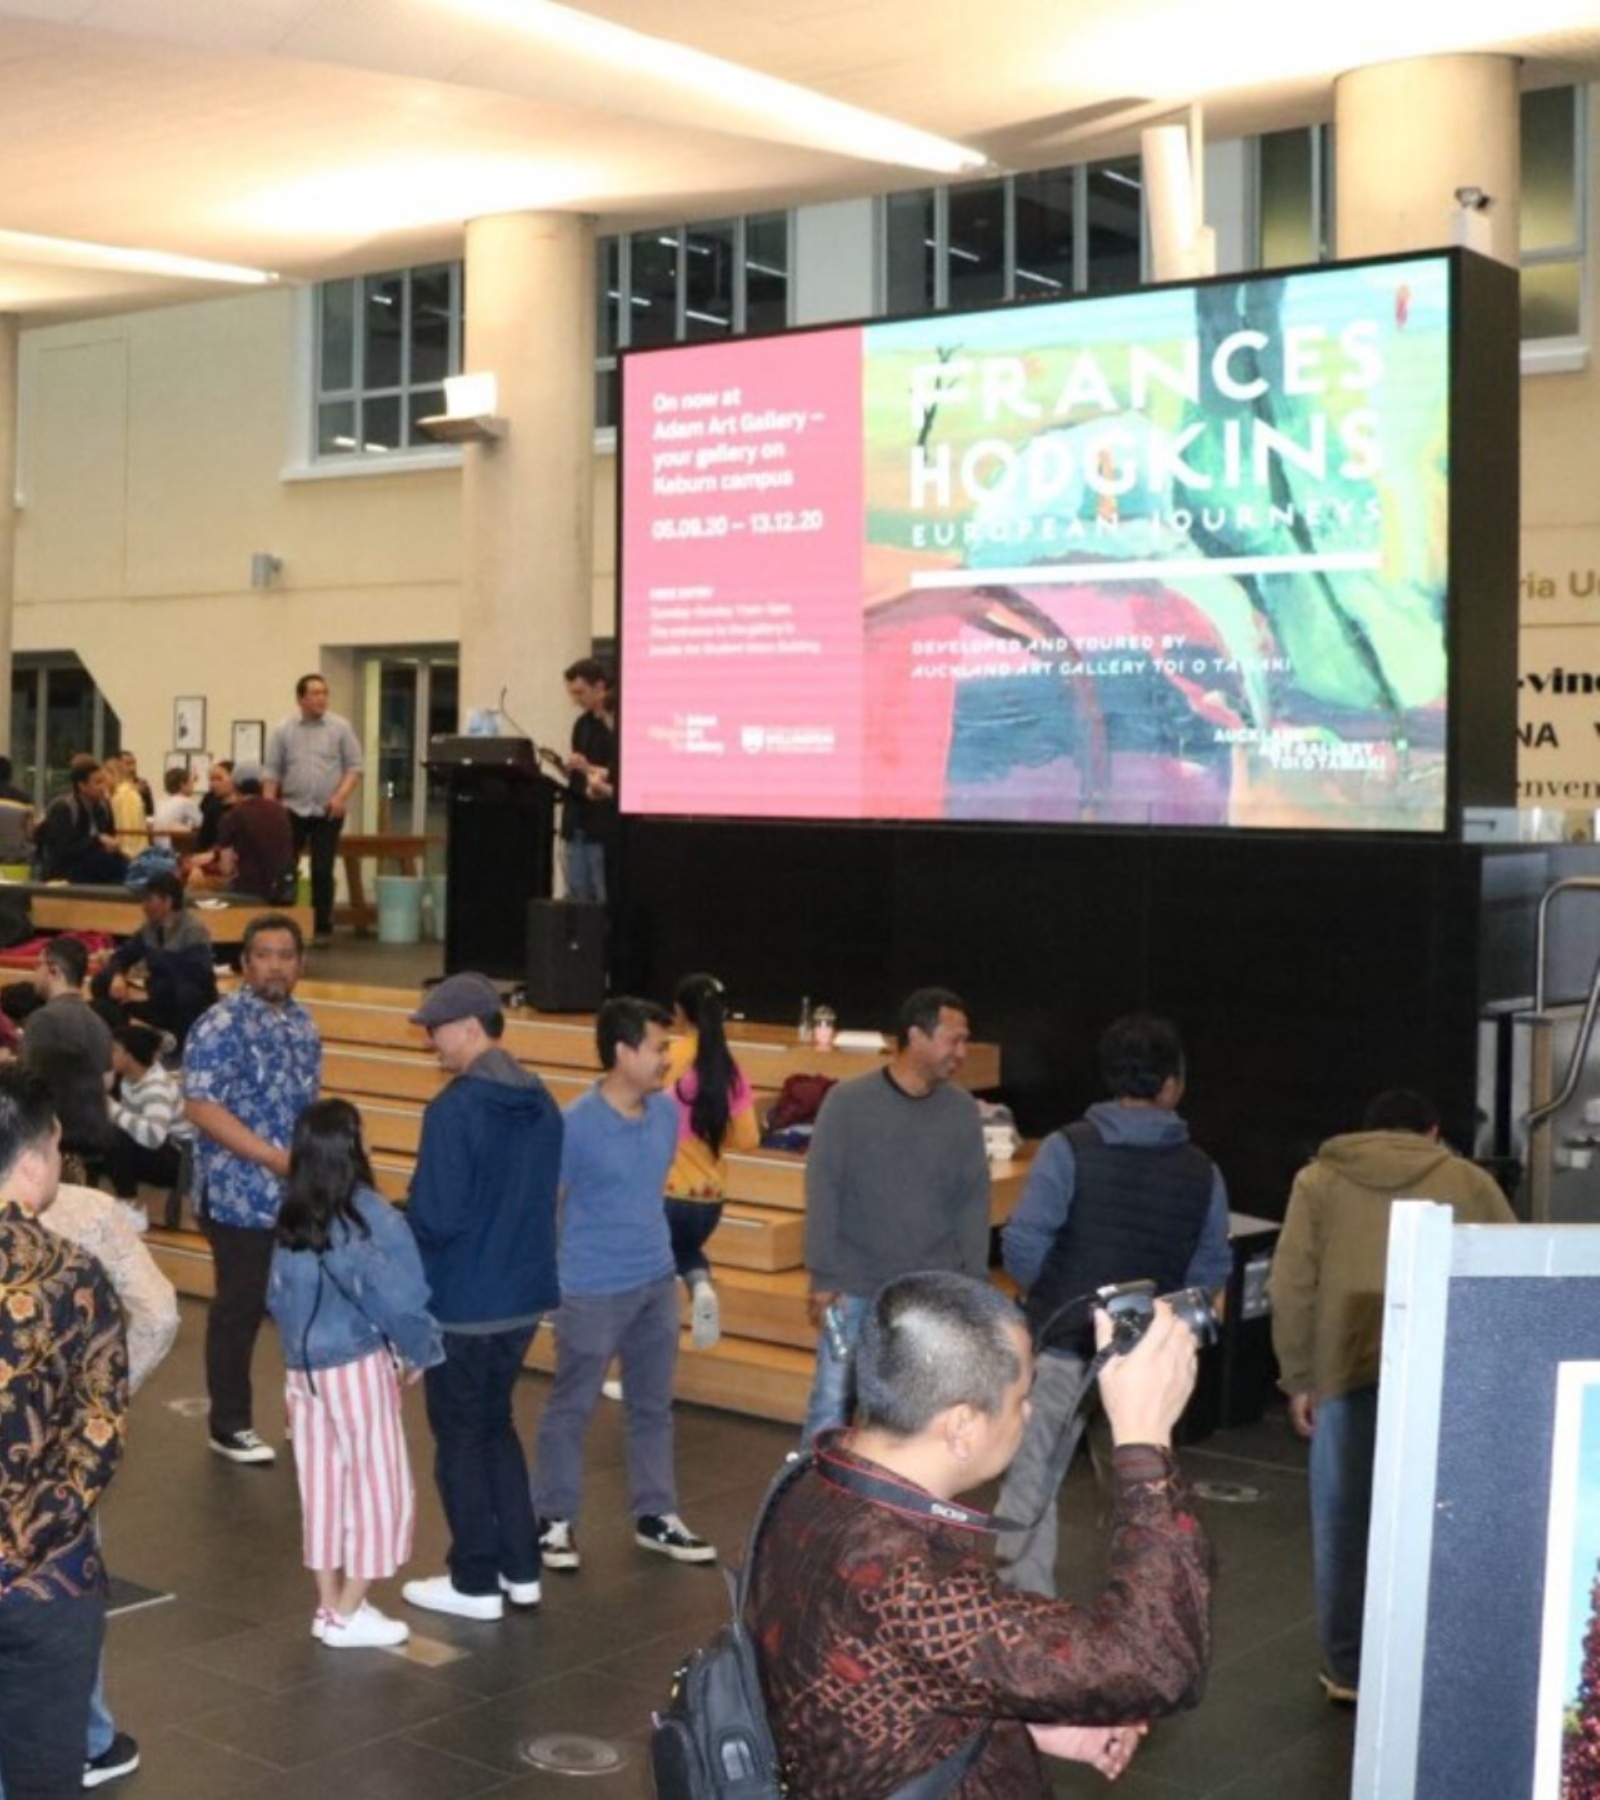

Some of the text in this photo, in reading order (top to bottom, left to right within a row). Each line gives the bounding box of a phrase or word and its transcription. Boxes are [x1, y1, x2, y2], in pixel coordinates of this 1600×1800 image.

[910, 320, 1384, 428] FRANCES
[653, 387, 742, 413] On now at
[652, 418, 704, 441] Adam
[708, 416, 737, 434] Art
[741, 409, 807, 434] Gallery
[653, 442, 786, 473] your gallery on
[909, 408, 1384, 509] HODGKINS
[720, 469, 794, 492] campus
[912, 498, 1382, 548] EUROPEAN JOURNEYS
[1568, 569, 1600, 598] U
[912, 633, 1188, 656] DEVELOPED AND TOURED BY
[911, 661, 1012, 679] AUCKLAND
[1014, 660, 1053, 677] ART
[1058, 658, 1146, 676] GALLERY
[1152, 657, 1184, 675] TOI
[1191, 657, 1206, 674] O
[1517, 667, 1600, 694] vin
